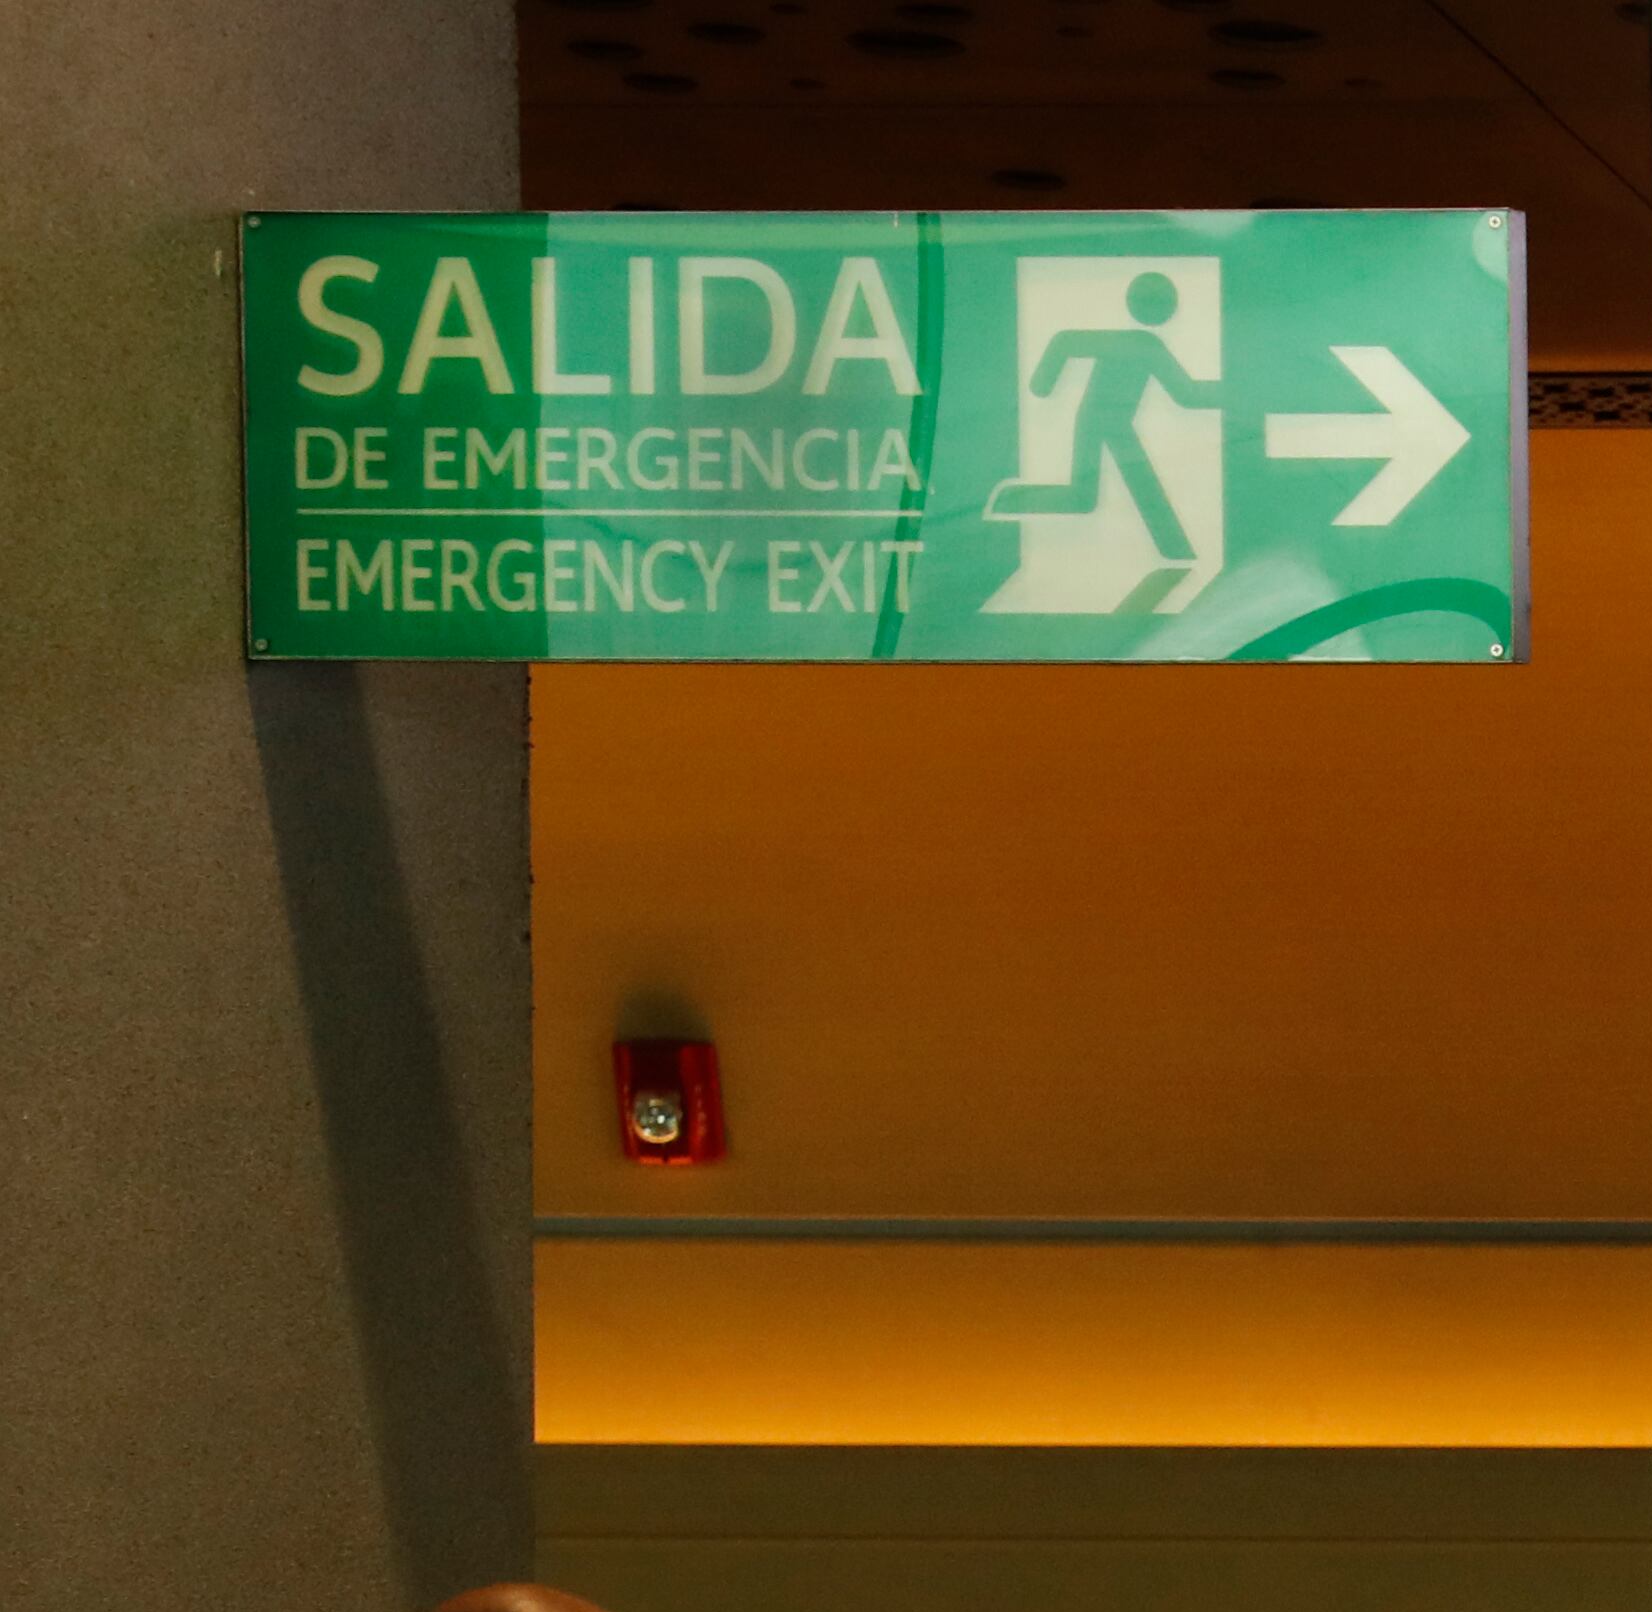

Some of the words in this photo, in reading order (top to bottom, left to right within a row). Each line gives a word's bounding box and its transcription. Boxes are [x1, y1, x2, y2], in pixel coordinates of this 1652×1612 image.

[297, 255, 924, 397] SALIDA
[295, 427, 388, 491] DE
[423, 427, 922, 492] EMERGENCIA
[297, 539, 734, 613] EMERGENCY
[768, 540, 924, 613] EXIT
